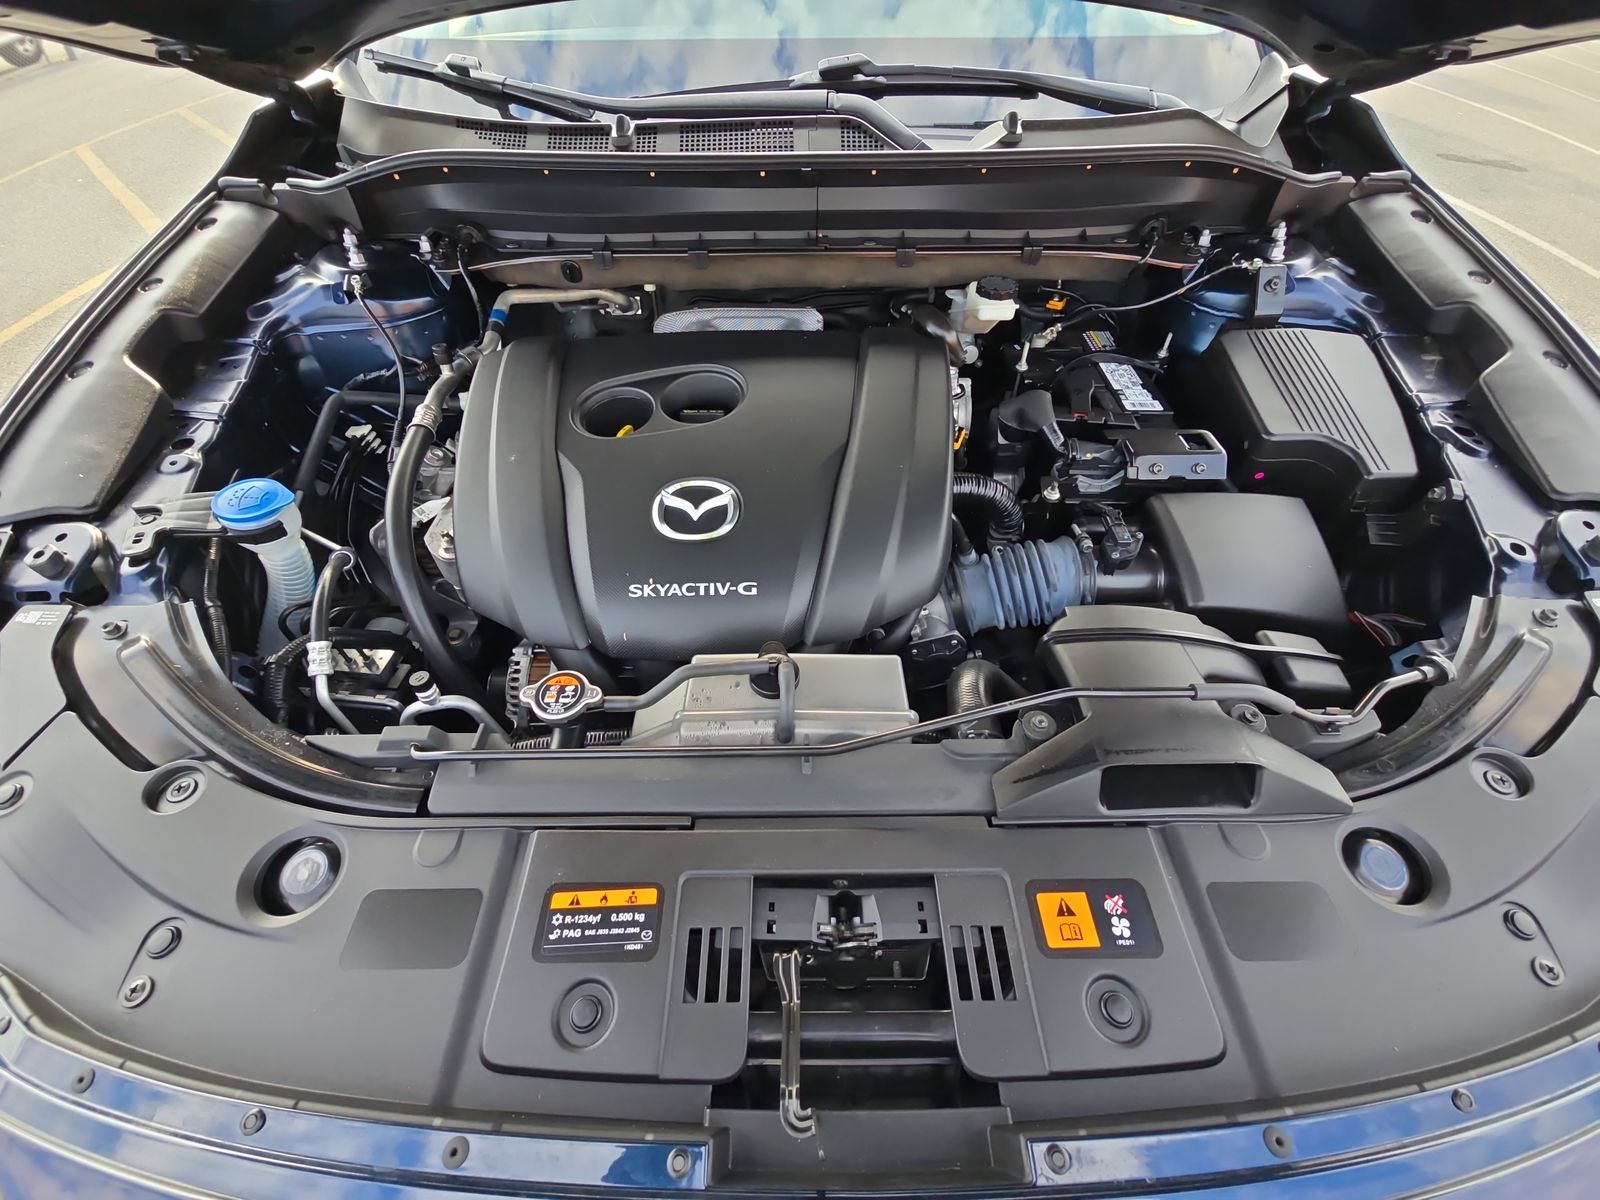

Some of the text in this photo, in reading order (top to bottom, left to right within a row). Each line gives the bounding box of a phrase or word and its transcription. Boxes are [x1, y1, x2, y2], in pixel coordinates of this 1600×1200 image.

[628, 582, 758, 598] SKYACTIV-G
[564, 912, 645, 924] R-1234yf 0.500 kg
[562, 928, 582, 938] PAG
